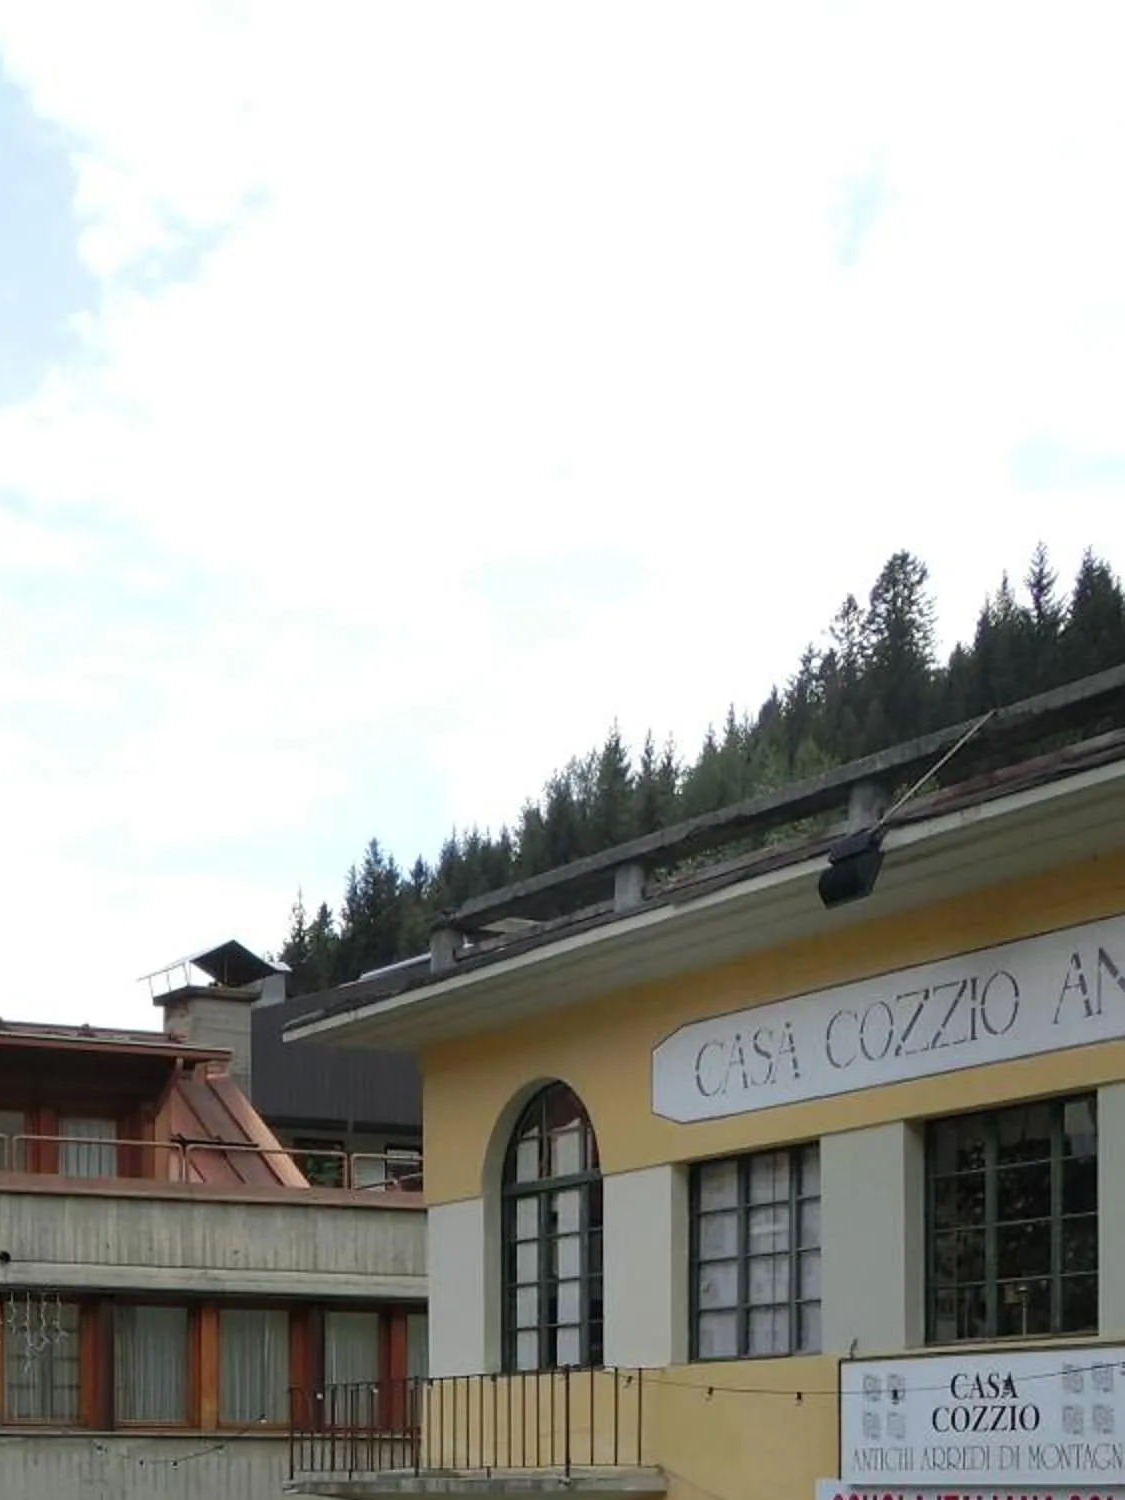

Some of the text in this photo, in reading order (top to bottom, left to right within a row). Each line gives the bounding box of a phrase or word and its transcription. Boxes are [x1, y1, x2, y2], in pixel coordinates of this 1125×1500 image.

[695, 1021, 801, 1098] CASA
[825, 970, 1021, 1070] COZZIO
[950, 1371, 1019, 1400] CASA
[932, 1403, 1041, 1433] COZZIO
[853, 1446, 914, 1473] ANTICHI
[920, 1444, 990, 1472] ARREDI
[1000, 1444, 1020, 1471] DI
